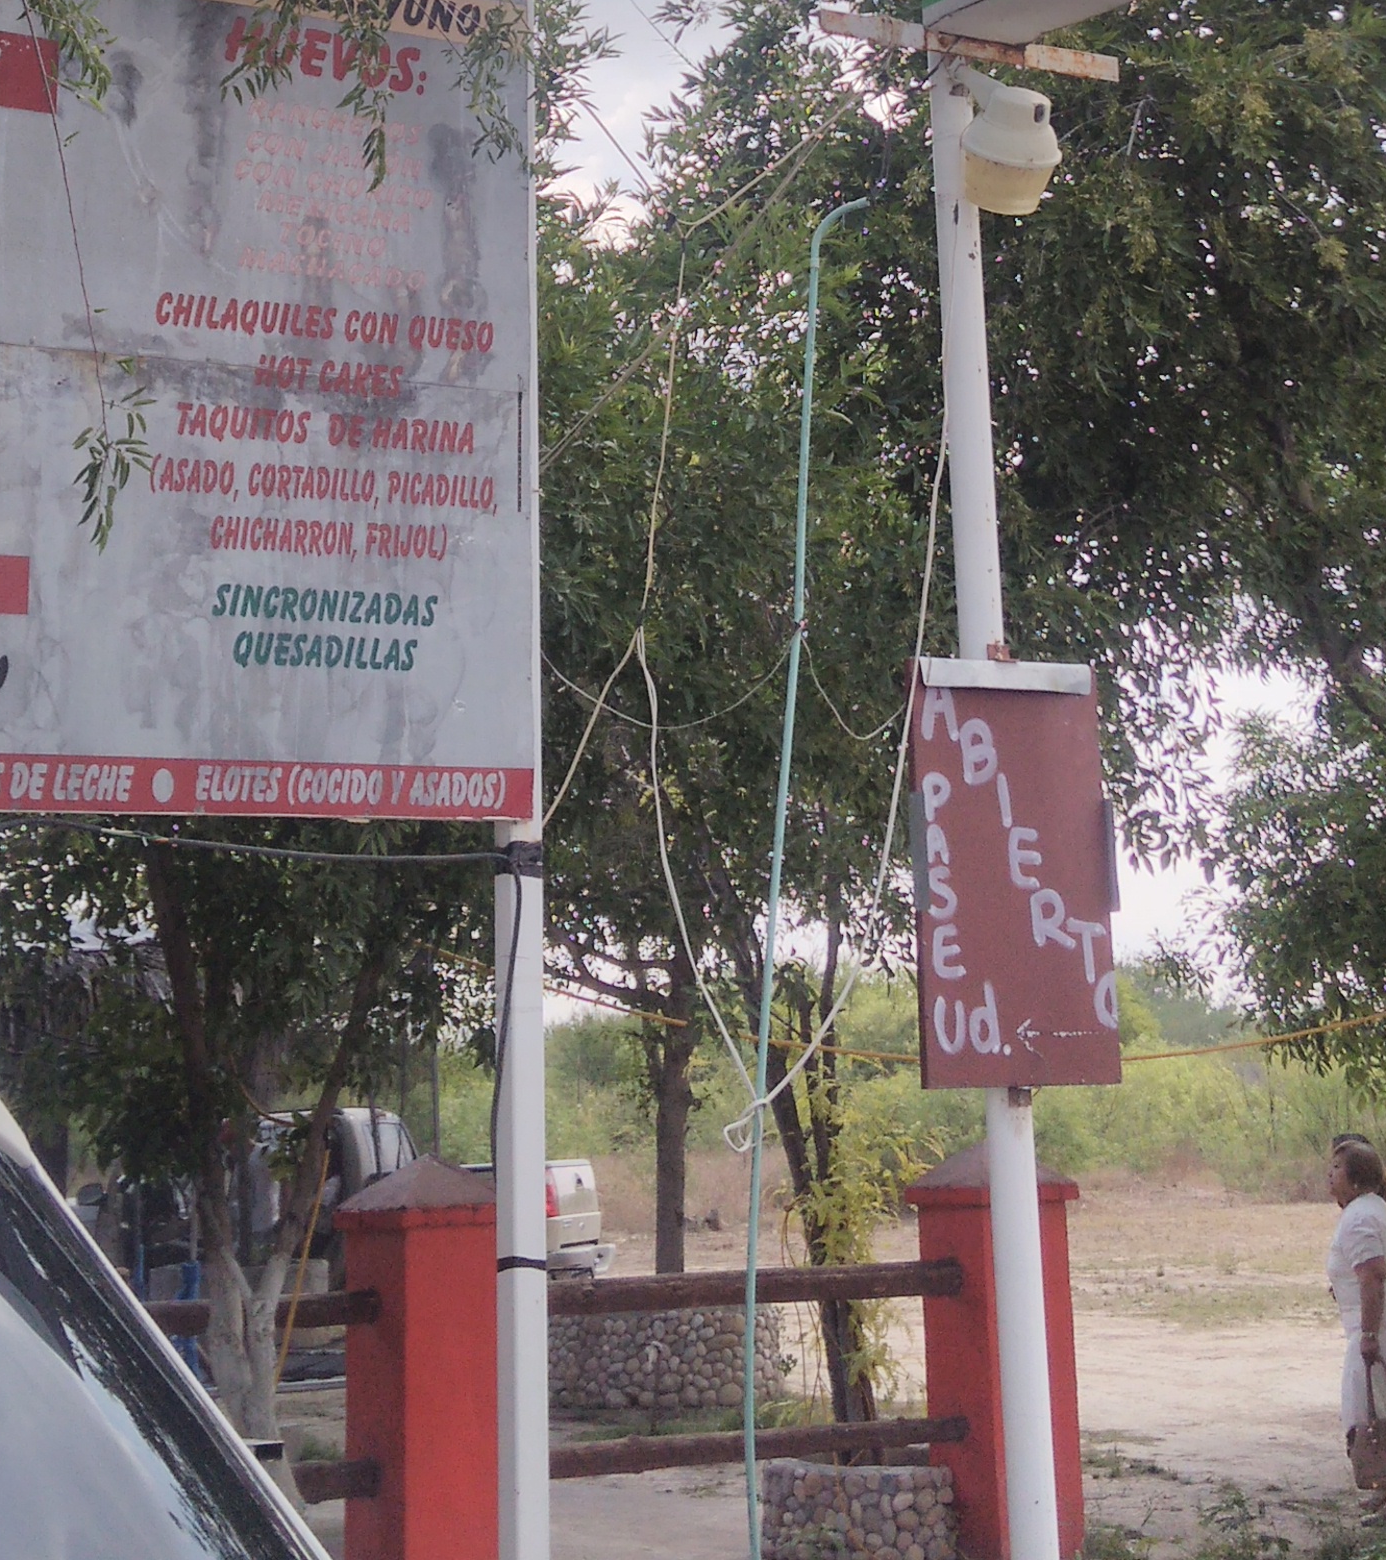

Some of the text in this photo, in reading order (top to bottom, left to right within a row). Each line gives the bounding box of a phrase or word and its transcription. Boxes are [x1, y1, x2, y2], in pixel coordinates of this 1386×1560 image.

[155, 292, 496, 354] CHILAQUILES CON QUESO
[253, 354, 404, 398] HOT CAKES
[175, 401, 476, 455] TAQUITOS DE HARINA
[248, 463, 380, 511] CORTADILLO,
[387, 470, 499, 517] PICADILLO,
[211, 515, 449, 563] CHICHARRON, FRIJOL)
[212, 583, 440, 628] SINCRONIZADAS
[231, 630, 419, 672] QUESADILLAS
[9, 762, 46, 801] DE
[51, 763, 135, 804] LECHE
[196, 764, 507, 811] ELOTES (COCIDO Y ASADOS)
